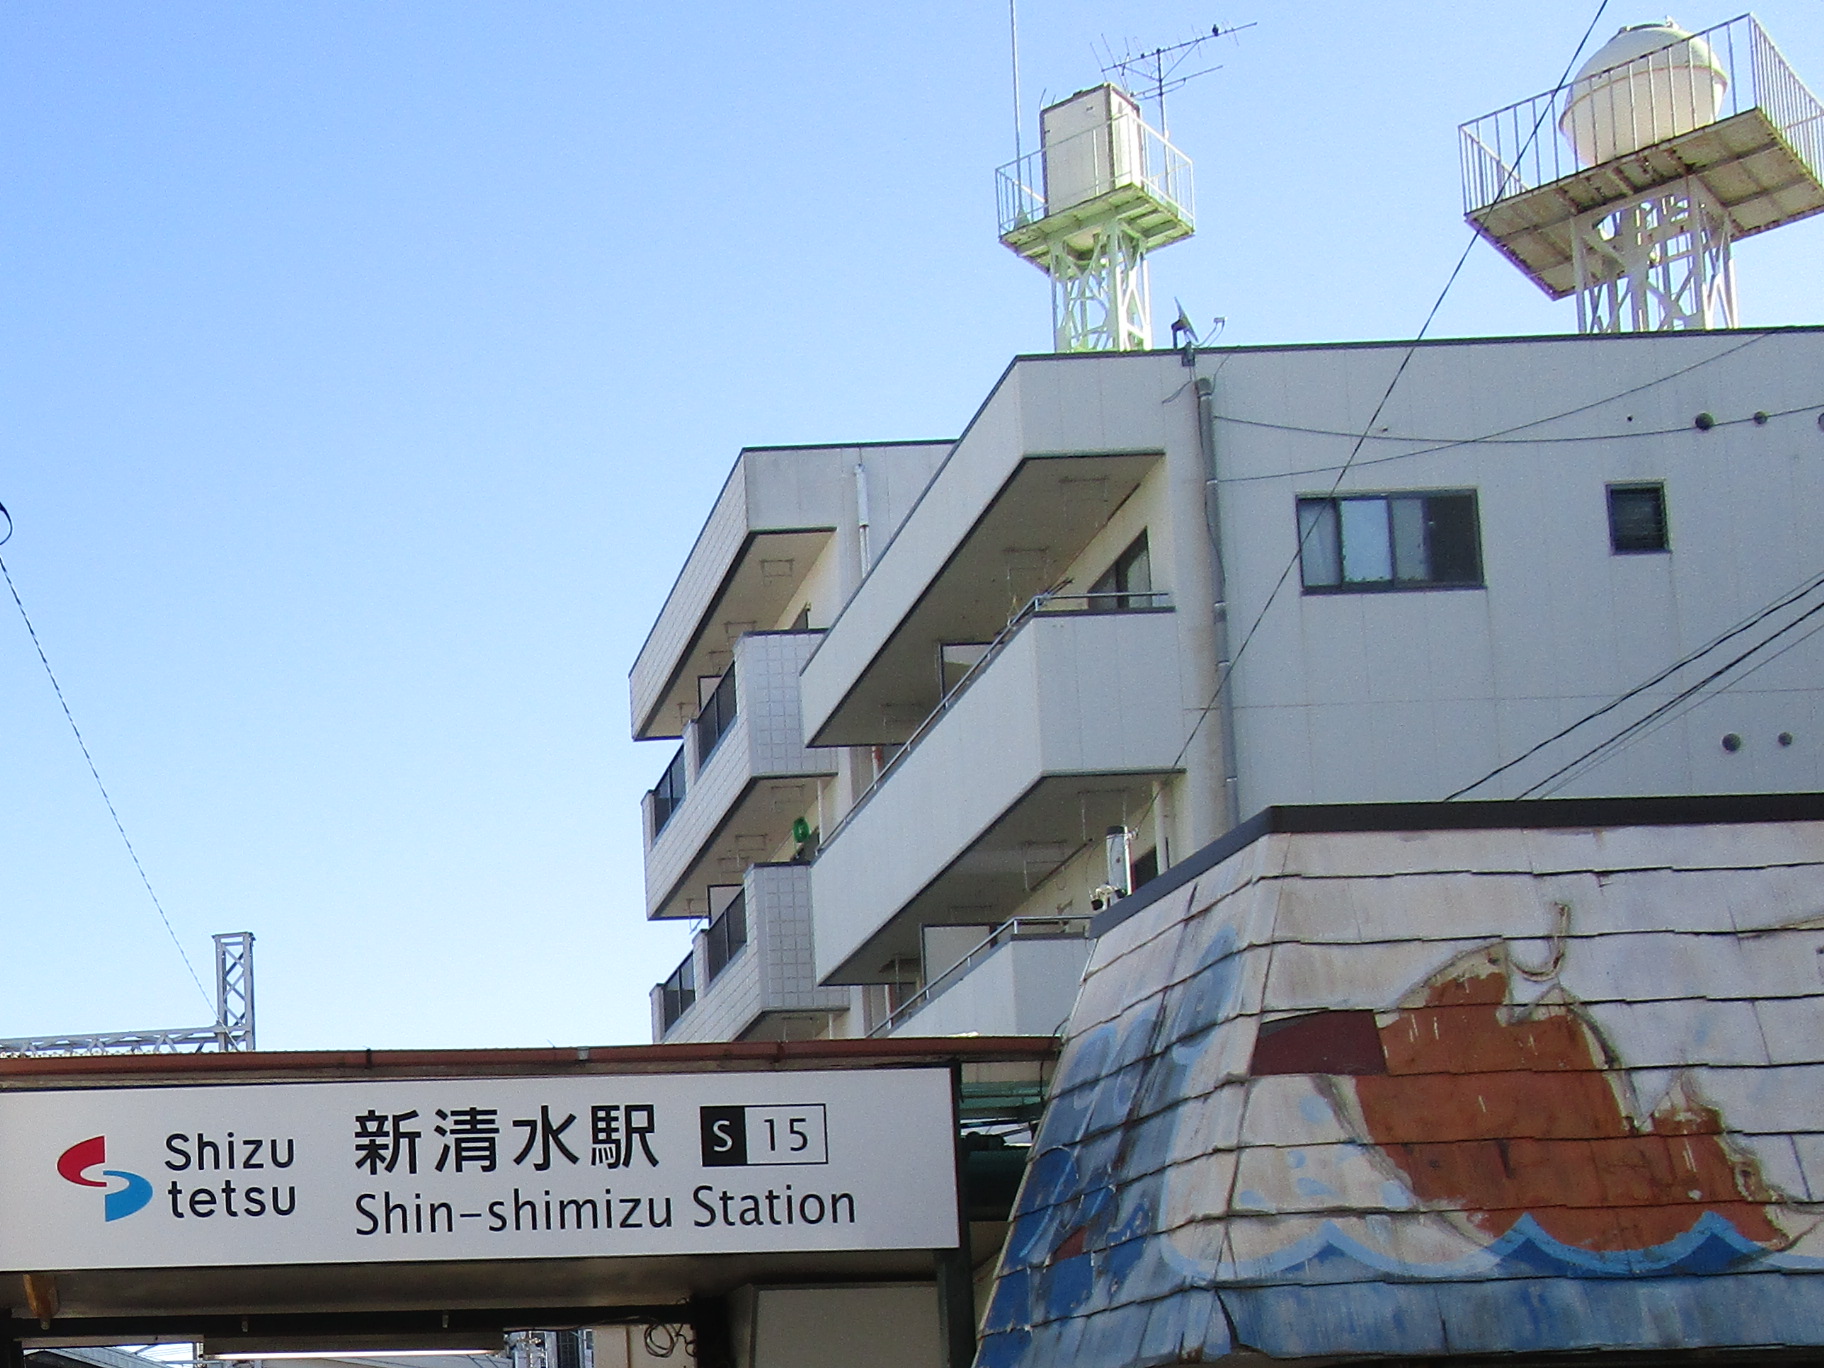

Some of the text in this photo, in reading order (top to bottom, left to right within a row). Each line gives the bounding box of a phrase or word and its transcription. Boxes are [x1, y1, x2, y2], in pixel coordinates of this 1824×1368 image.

[164, 1131, 295, 1171] Shizu
[354, 1102, 659, 1176] 新清水駅
[713, 1118, 809, 1152] S 15
[167, 1179, 296, 1218] tetsu
[355, 1184, 856, 1236] Shin-shimizu Station
